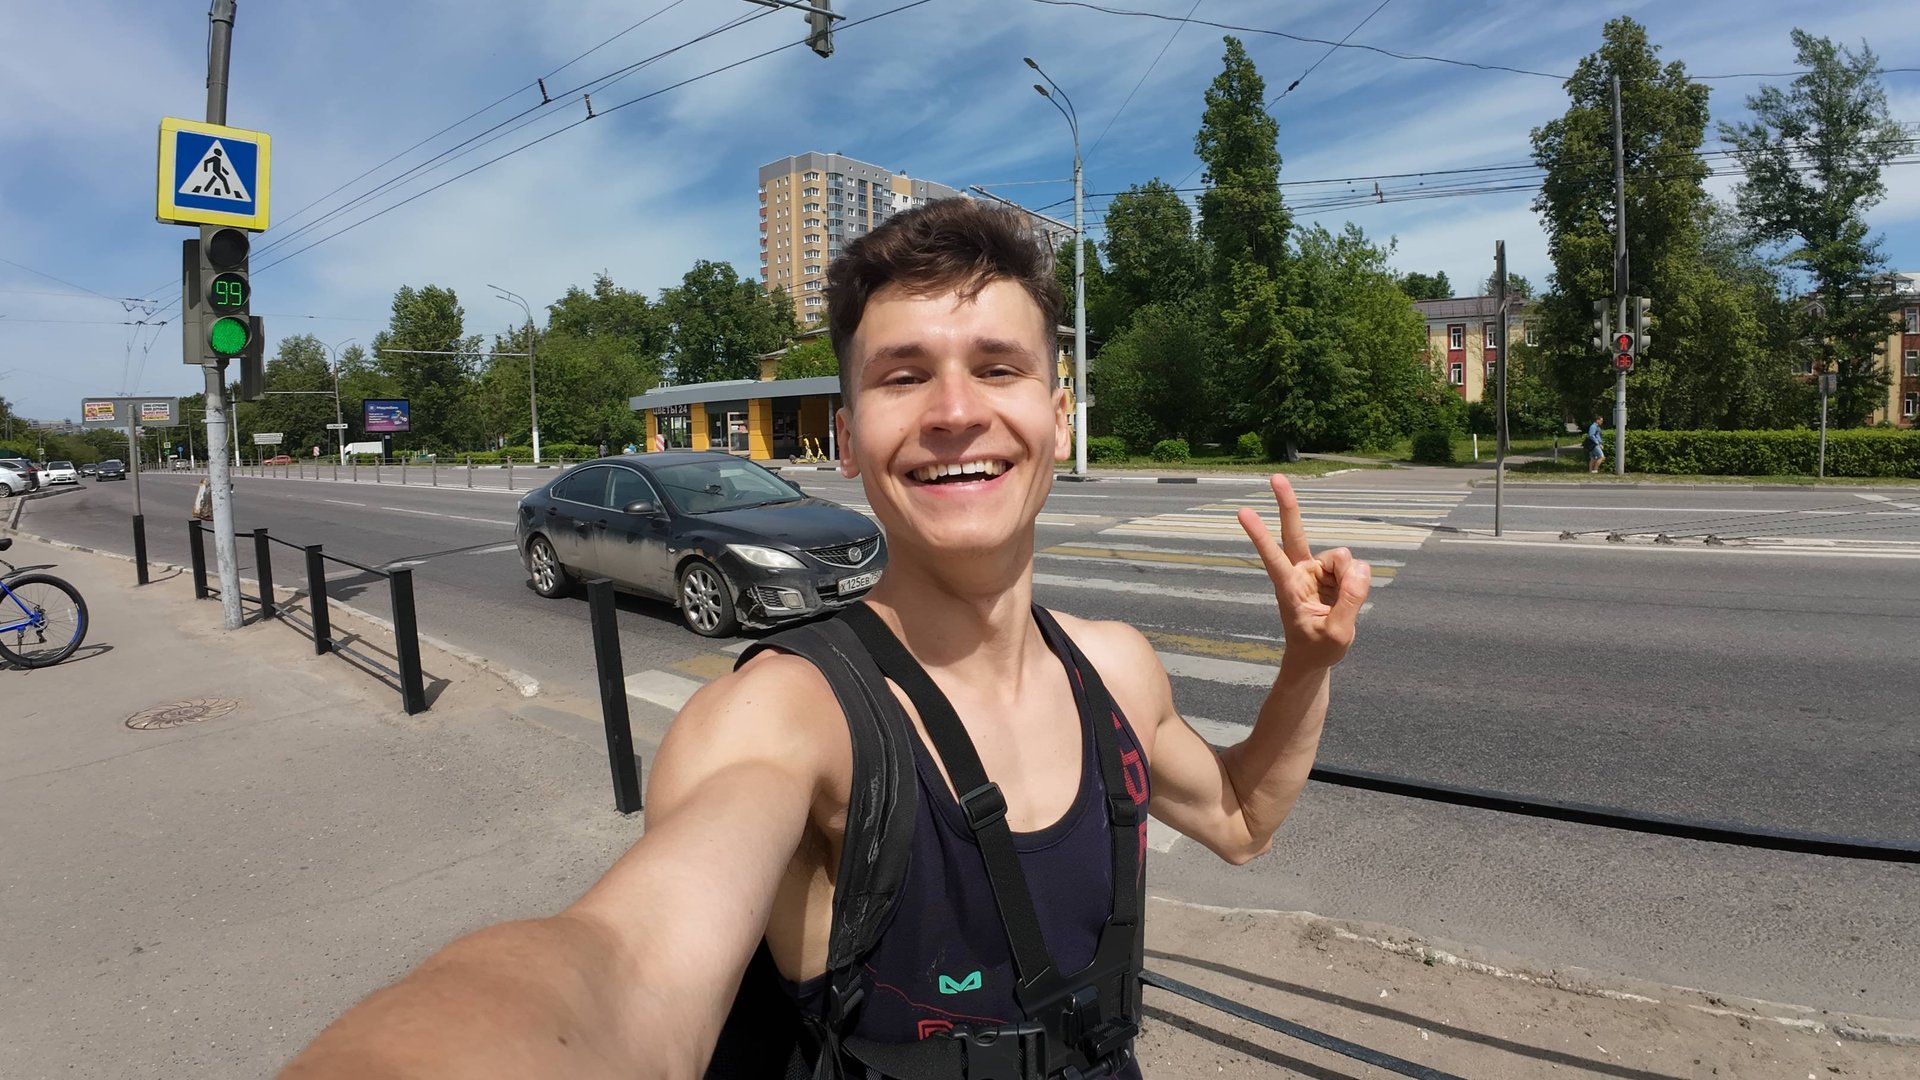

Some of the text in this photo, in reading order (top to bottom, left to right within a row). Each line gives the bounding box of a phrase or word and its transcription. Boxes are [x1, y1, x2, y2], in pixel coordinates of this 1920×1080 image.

[216, 281, 242, 306] 99
[652, 405, 688, 416] ЦВЕТЫ 24
